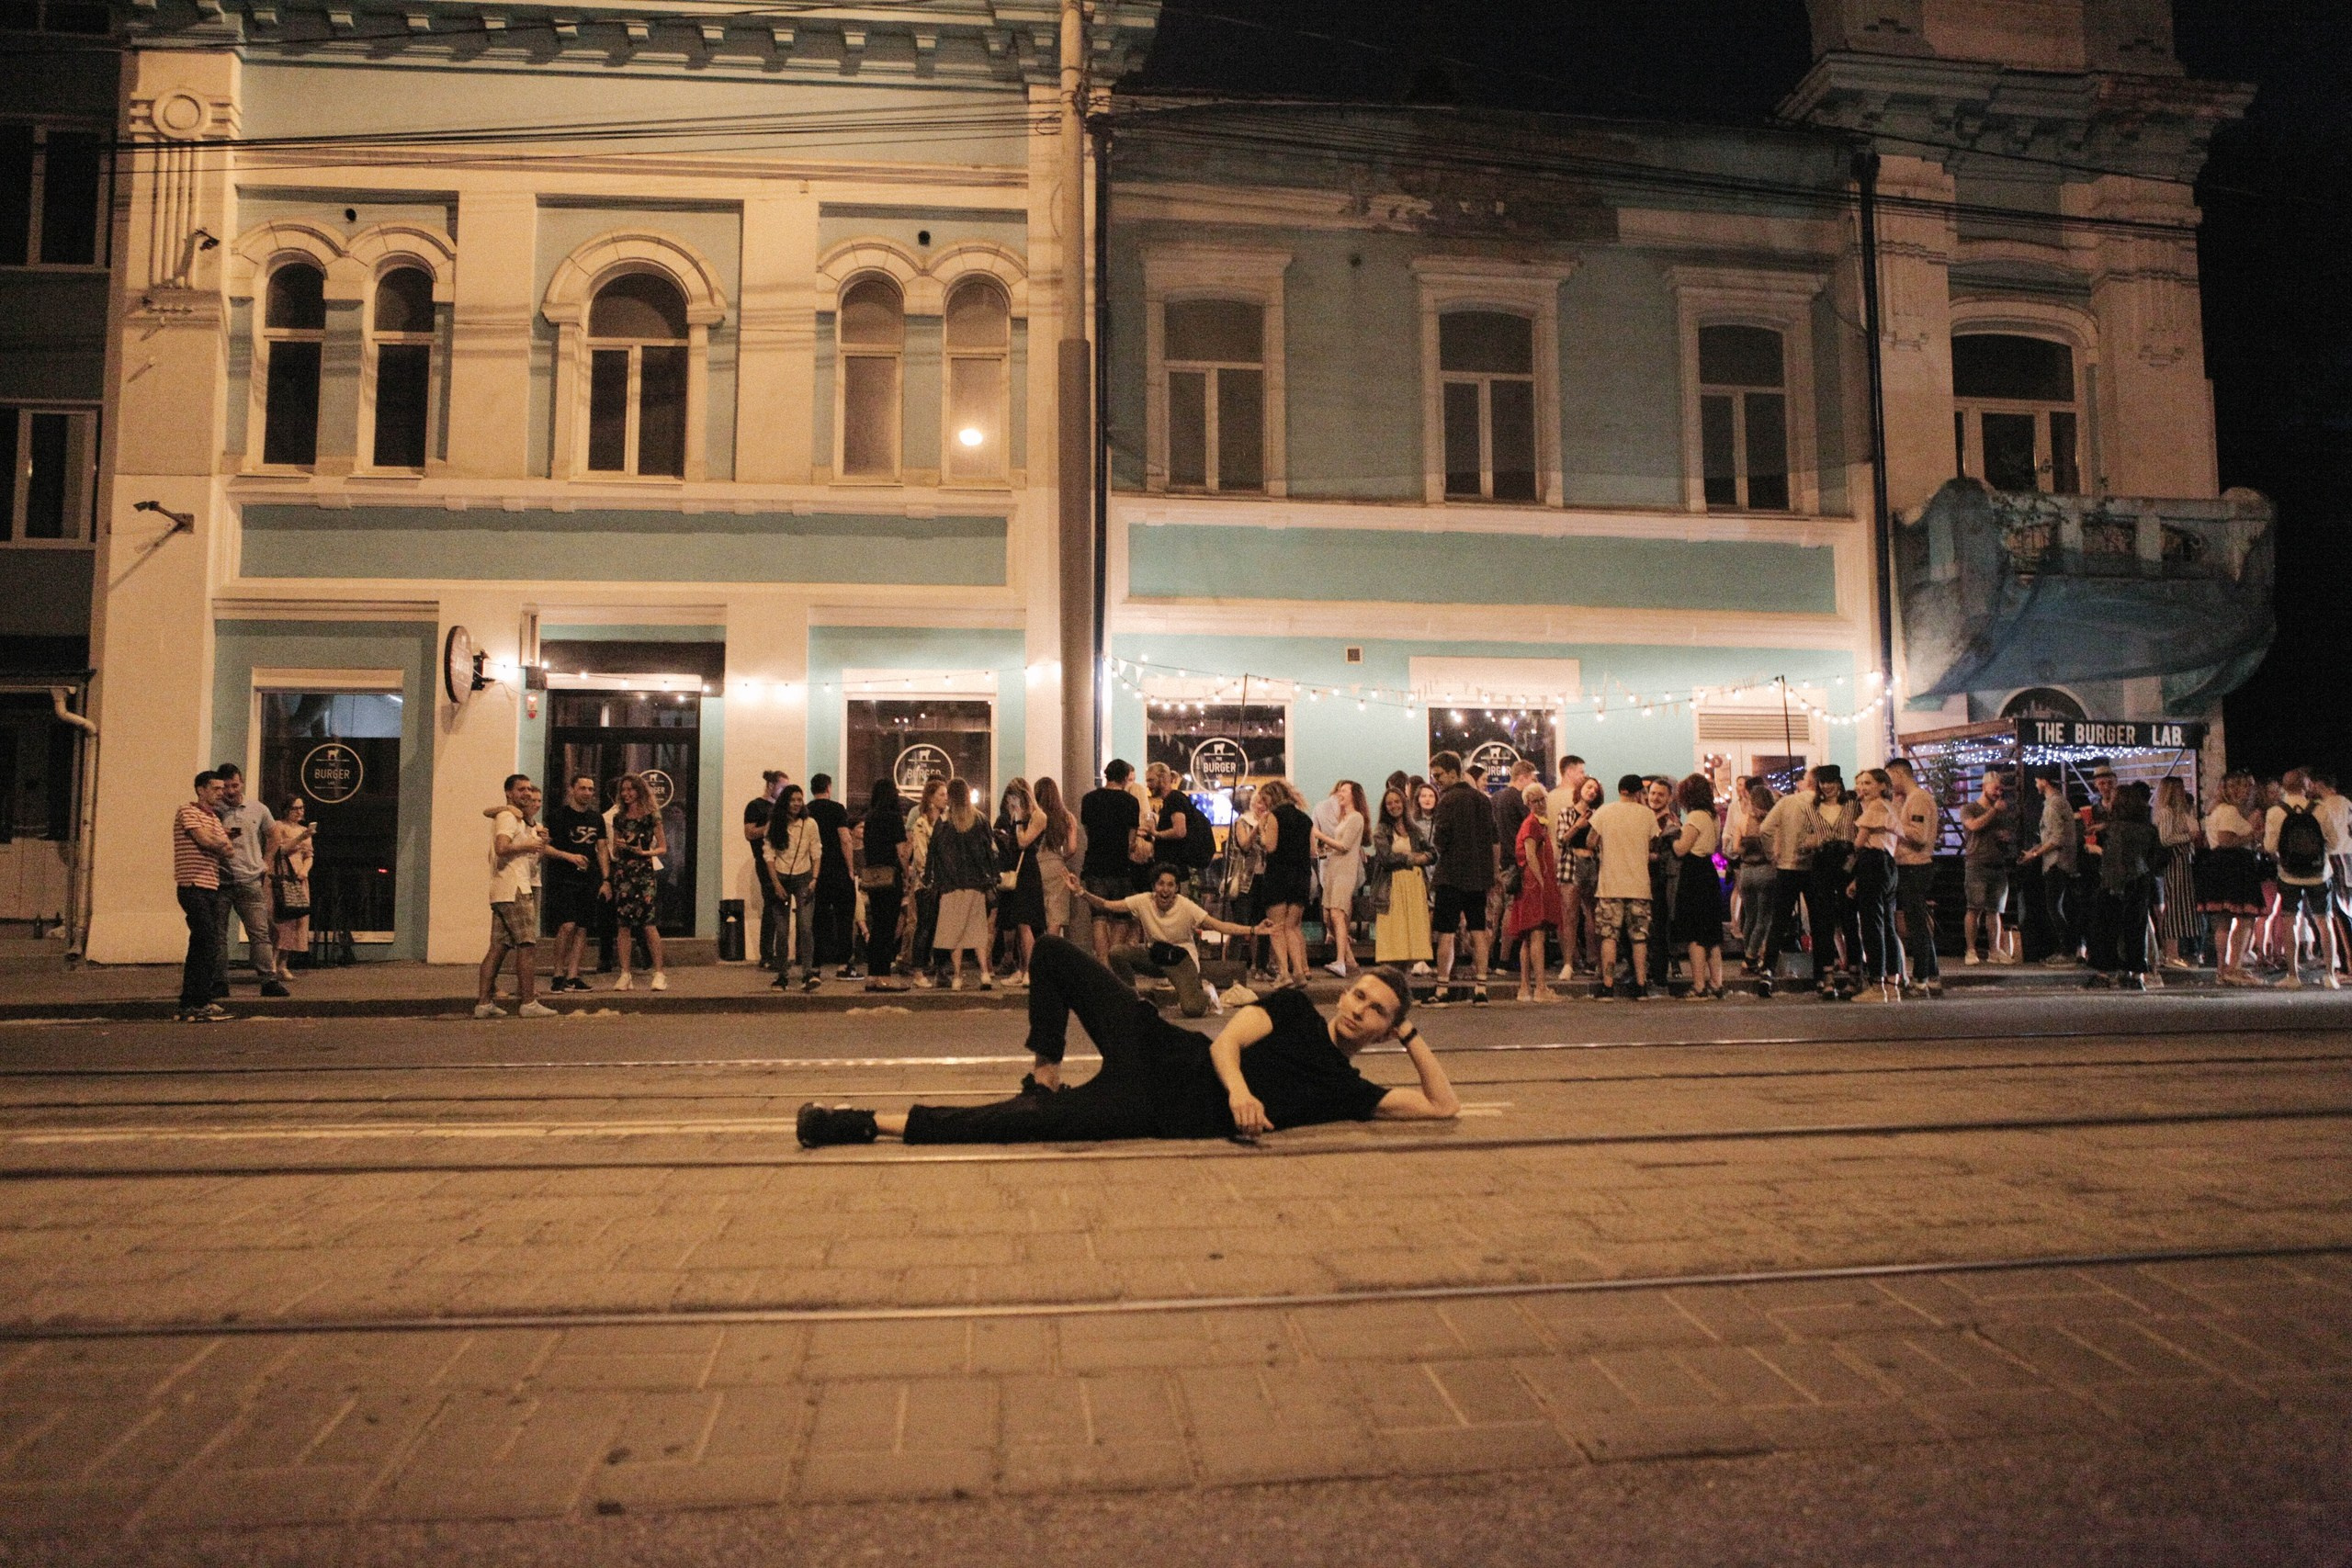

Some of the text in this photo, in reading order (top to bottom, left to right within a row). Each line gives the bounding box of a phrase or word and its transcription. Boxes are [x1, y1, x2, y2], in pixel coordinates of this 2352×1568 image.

[2035, 722, 2186, 747] THE BURGER LAB.
[1203, 762, 1237, 773] BURGER
[314, 768, 350, 779] BURGER
